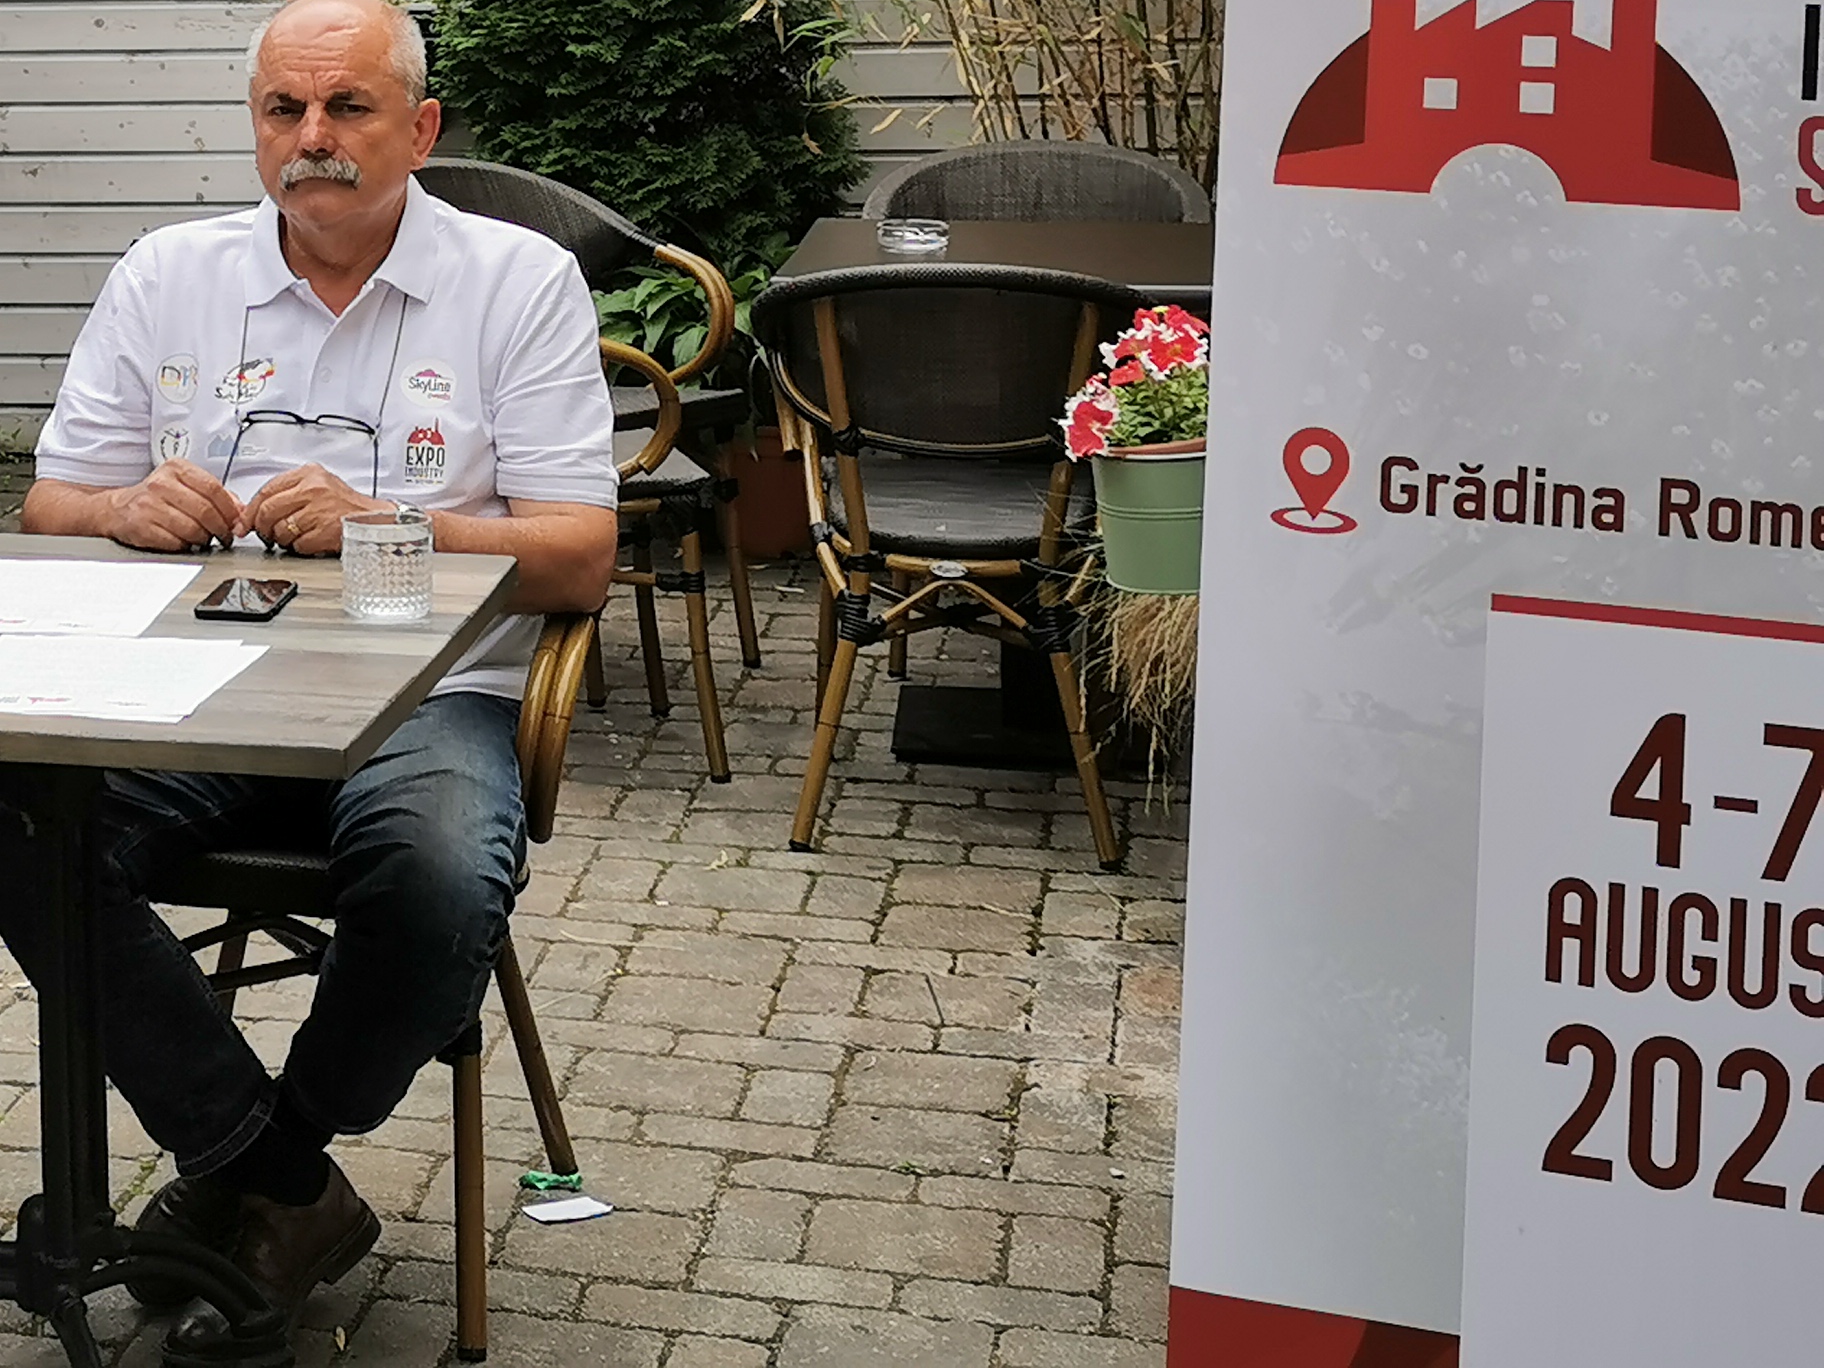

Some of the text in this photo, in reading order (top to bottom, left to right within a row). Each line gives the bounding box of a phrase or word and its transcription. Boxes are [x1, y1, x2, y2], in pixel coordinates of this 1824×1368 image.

[406, 445, 445, 467] EXPO
[1379, 455, 1626, 533] Grădina
[1609, 712, 1824, 882] 4-7
